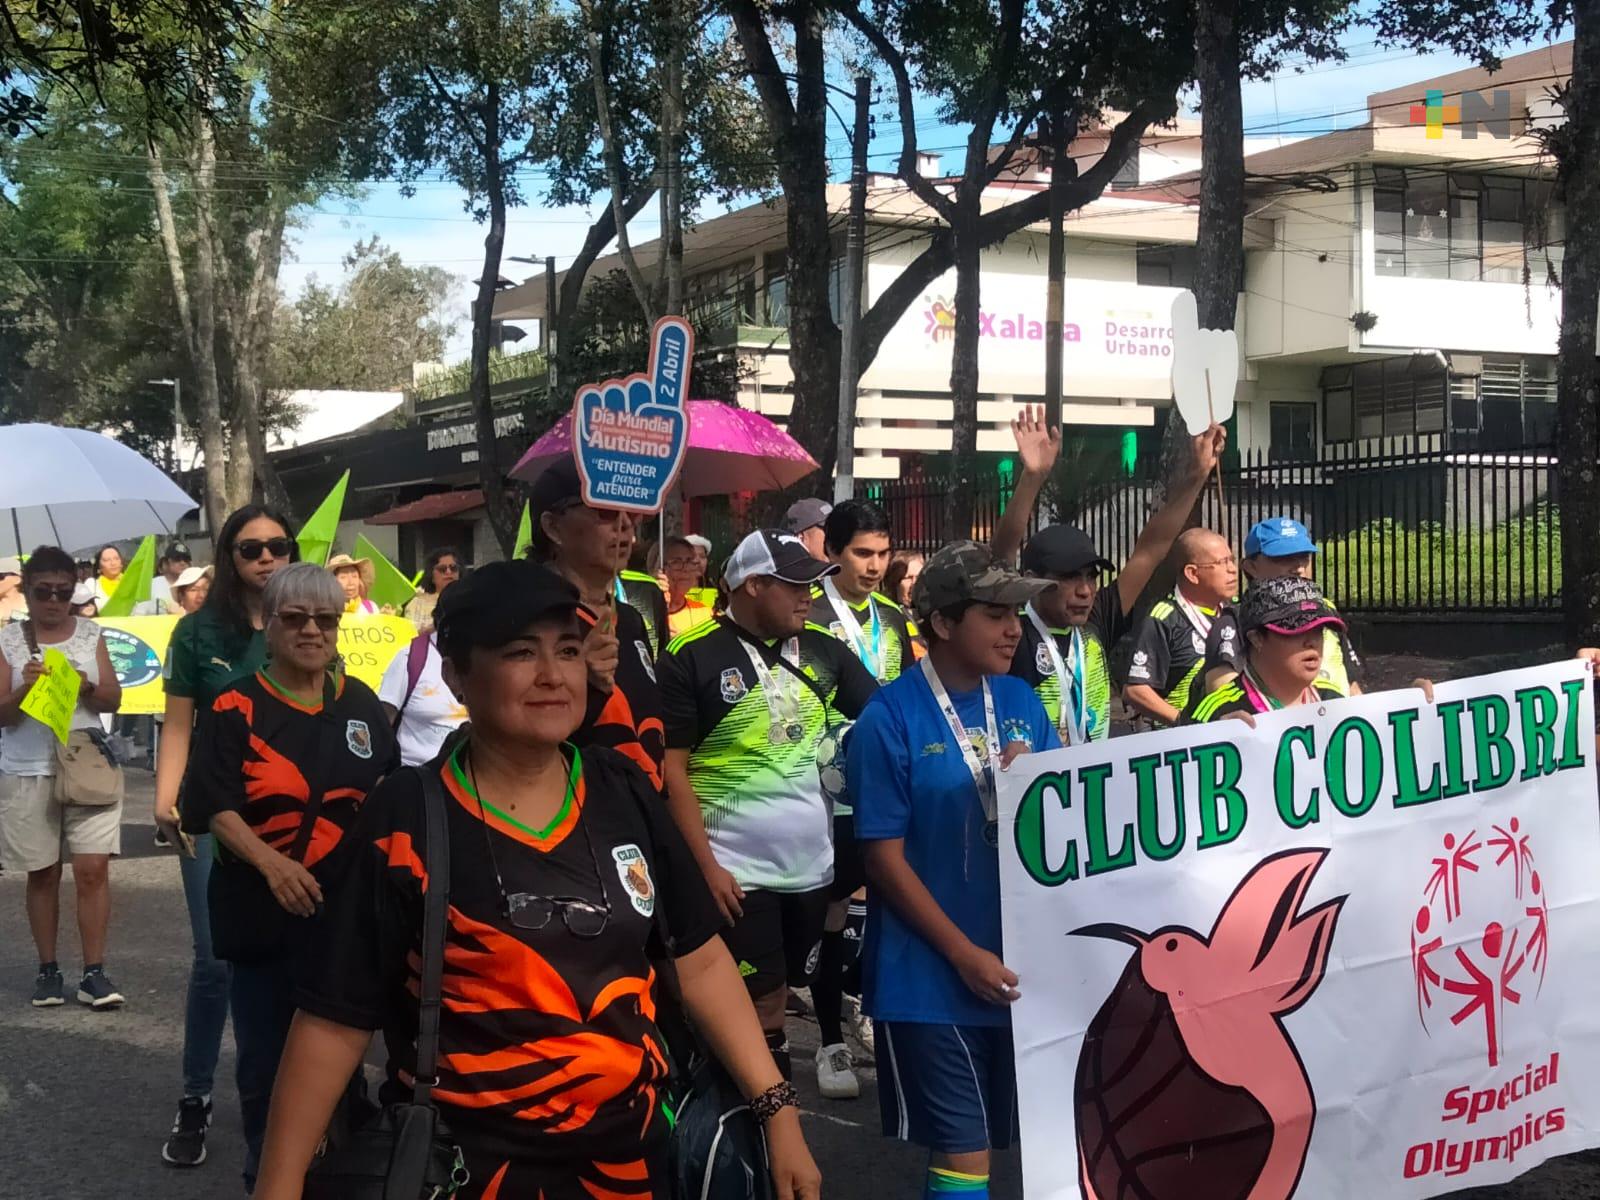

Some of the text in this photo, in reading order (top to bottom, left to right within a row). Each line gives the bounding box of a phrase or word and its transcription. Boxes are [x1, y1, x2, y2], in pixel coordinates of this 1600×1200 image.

[979, 312, 1081, 342] Xalaa
[1105, 339, 1171, 357] Urbano
[660, 337, 681, 399] 2 Abril
[592, 407, 615, 425] Día
[617, 411, 675, 434] Mundial
[588, 431, 670, 458] Autismo
[612, 474, 641, 485] para
[1013, 678, 1586, 888] CLUB COLIBRI
[1441, 1052, 1560, 1125] Special
[1402, 1107, 1566, 1179] Olympics
